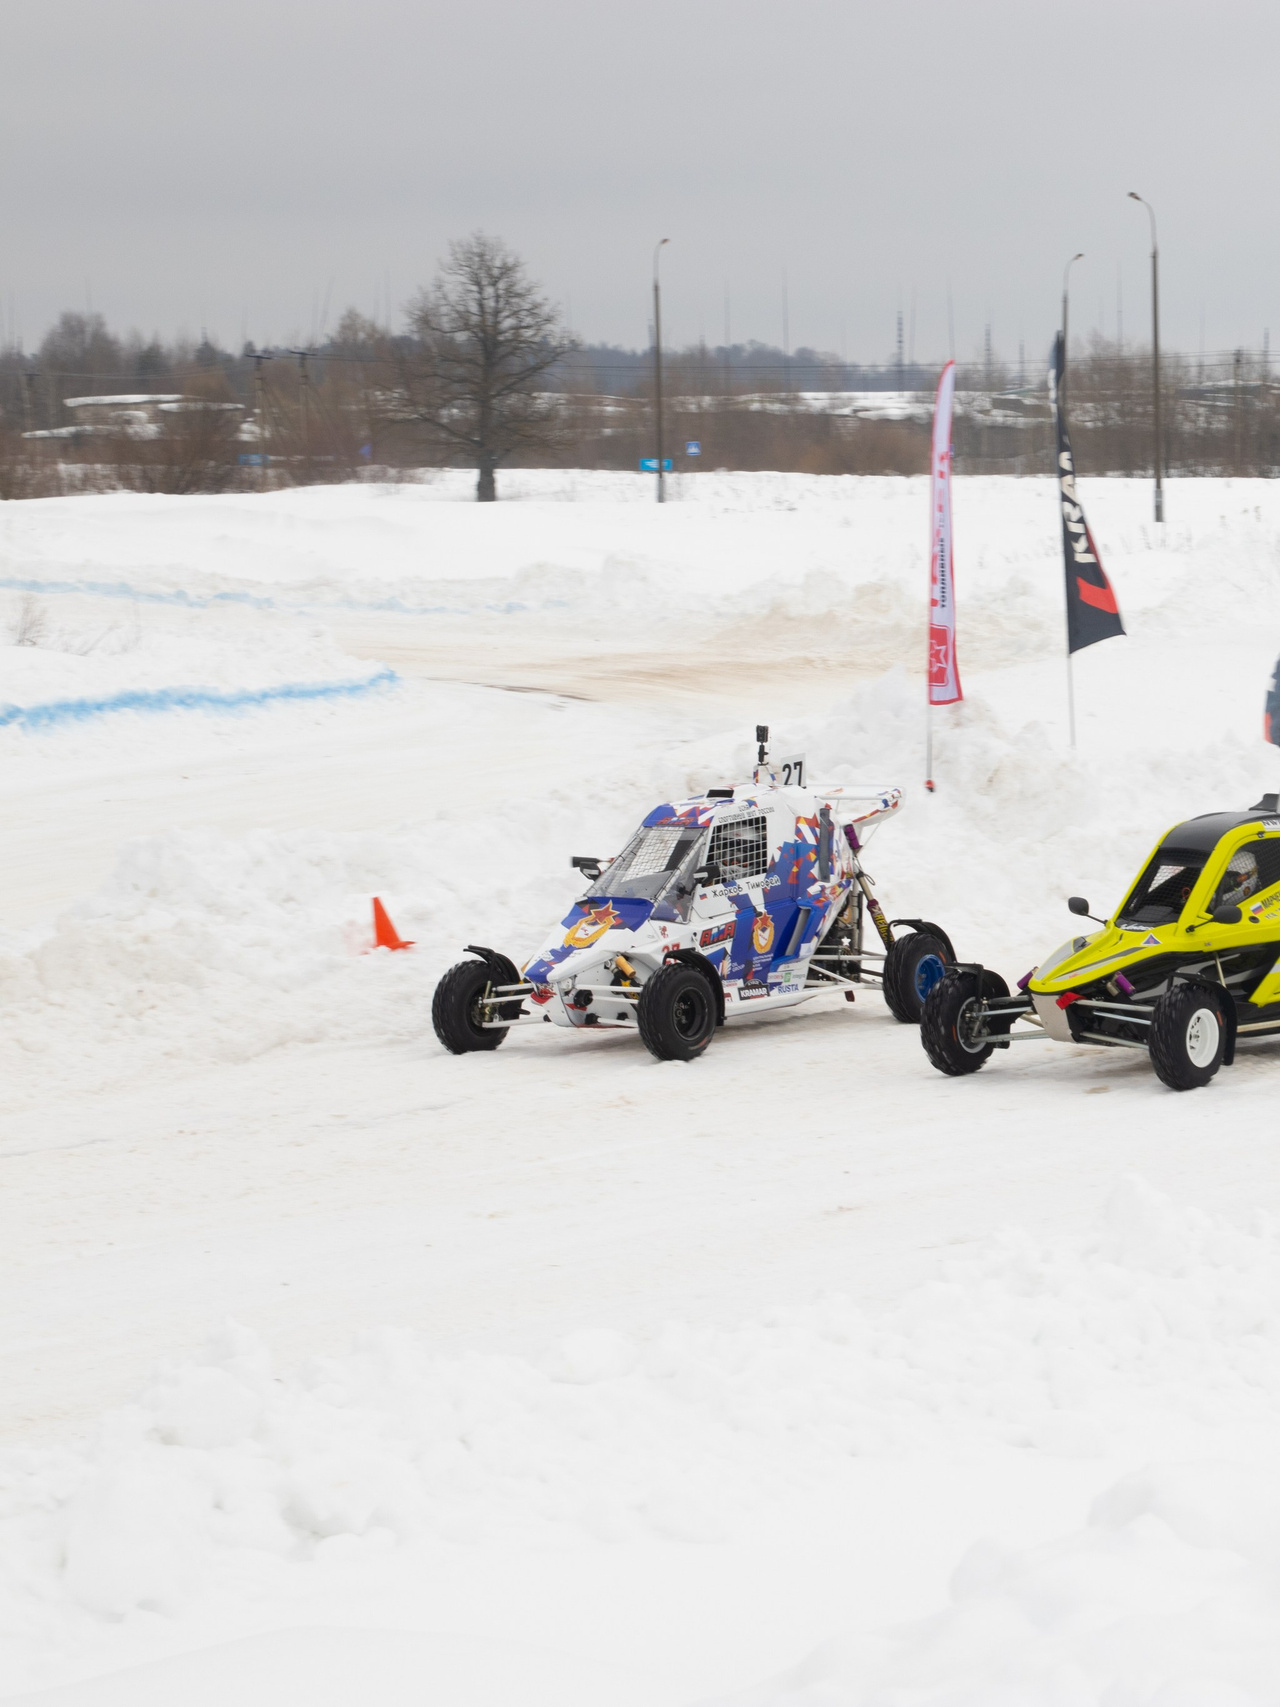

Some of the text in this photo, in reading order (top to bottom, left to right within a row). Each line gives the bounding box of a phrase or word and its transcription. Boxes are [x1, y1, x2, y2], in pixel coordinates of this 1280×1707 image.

[782, 760, 803, 786] 27
[711, 874, 781, 898] Жарков Тимофей
[740, 987, 768, 998] KRAMAR
